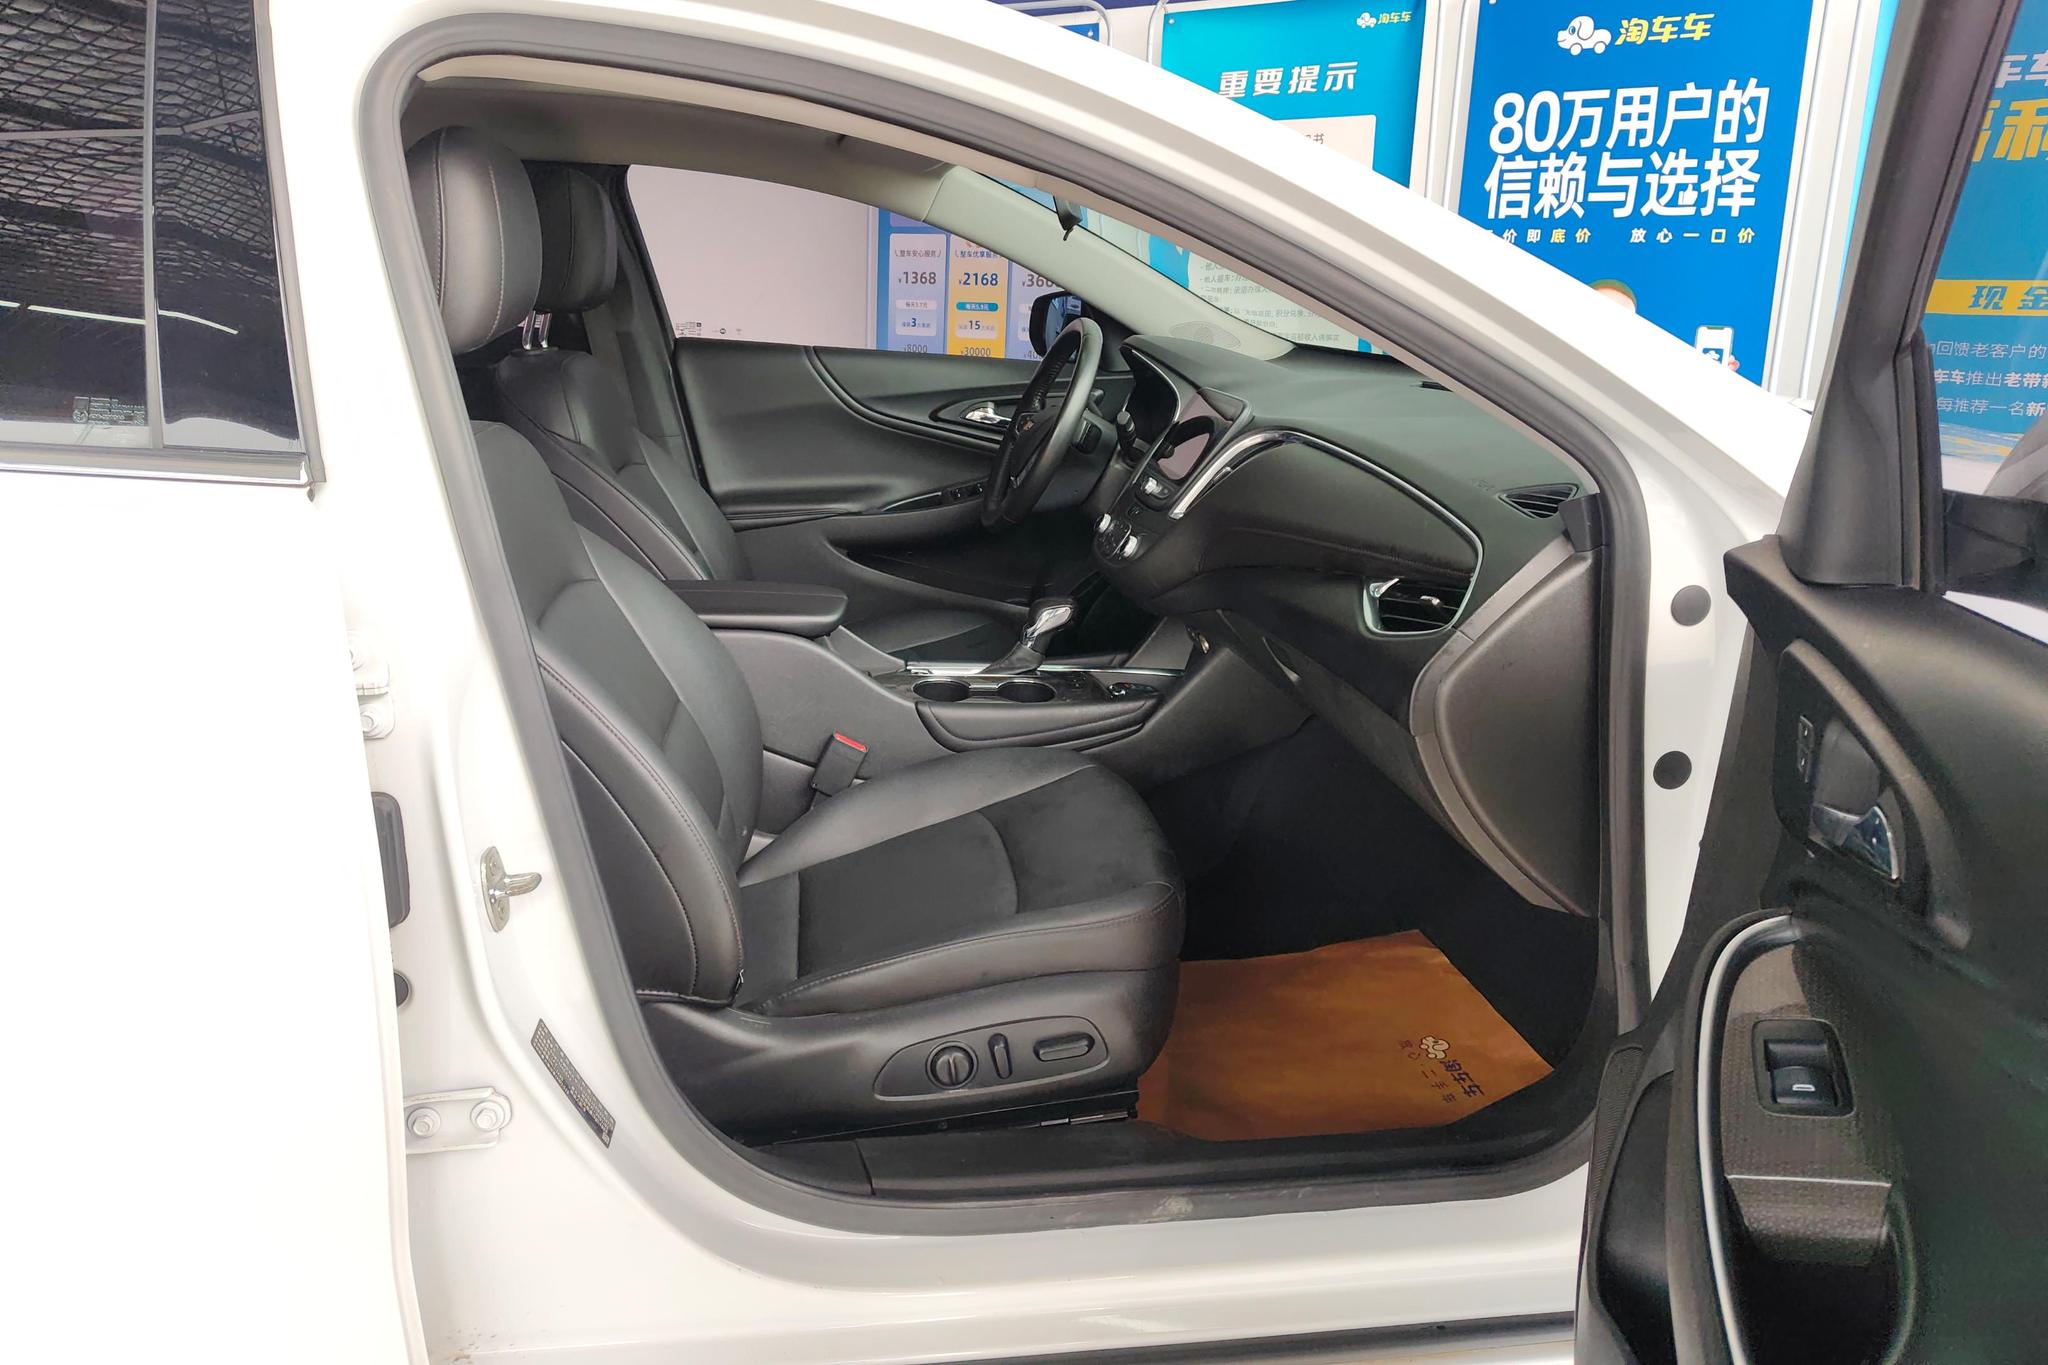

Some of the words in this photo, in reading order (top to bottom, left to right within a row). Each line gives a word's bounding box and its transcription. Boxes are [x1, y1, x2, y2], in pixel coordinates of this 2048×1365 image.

[1378, 11, 1412, 25] 淘车车
[1615, 12, 1715, 45] 淘车车
[1219, 61, 1358, 99] 重要提示
[1489, 77, 1770, 154] 80万用户的
[1484, 148, 1761, 220] 信赖与选择
[1486, 228, 1591, 244] 价即底价
[1630, 228, 1755, 244] 放心一口价
[1930, 340, 2047, 359] 回馈老客户的
[1937, 397, 2048, 417] 每推荐一名新
